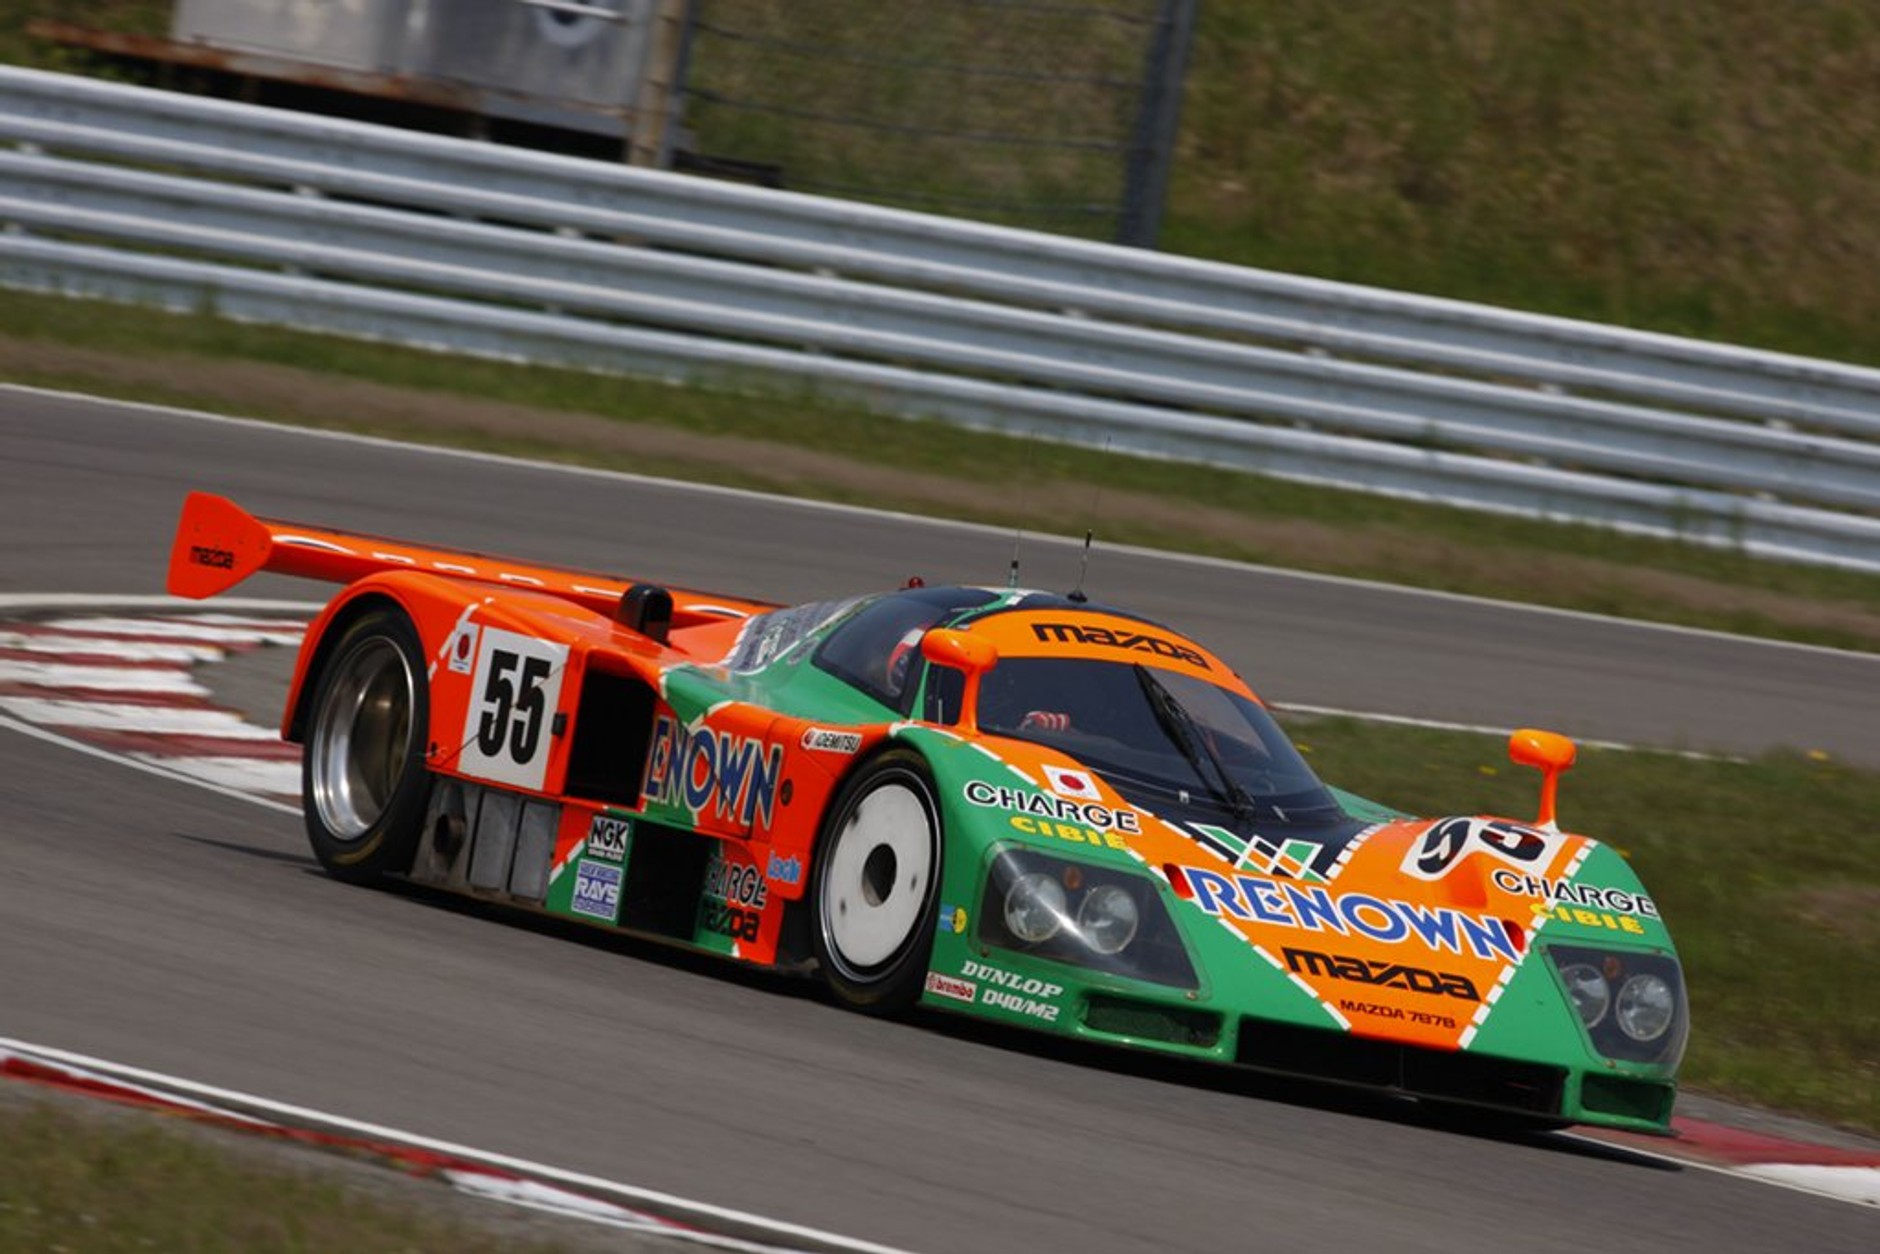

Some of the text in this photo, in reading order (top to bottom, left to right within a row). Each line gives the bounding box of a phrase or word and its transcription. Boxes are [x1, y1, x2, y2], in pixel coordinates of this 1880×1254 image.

[1031, 623, 1213, 672] mazda
[478, 648, 552, 765] 55
[813, 731, 860, 752] IDEMITSU
[642, 714, 784, 832] ENOWN
[963, 779, 1142, 835] CHARGE
[591, 820, 627, 850] NGK
[576, 877, 618, 904] RAYS
[1183, 865, 1523, 966] RENOWN
[1493, 870, 1660, 921] CHARGE
[961, 960, 1063, 998] DUNLOP
[1281, 947, 1482, 1001] mazda
[1340, 999, 1456, 1029] MAZDA 787B
